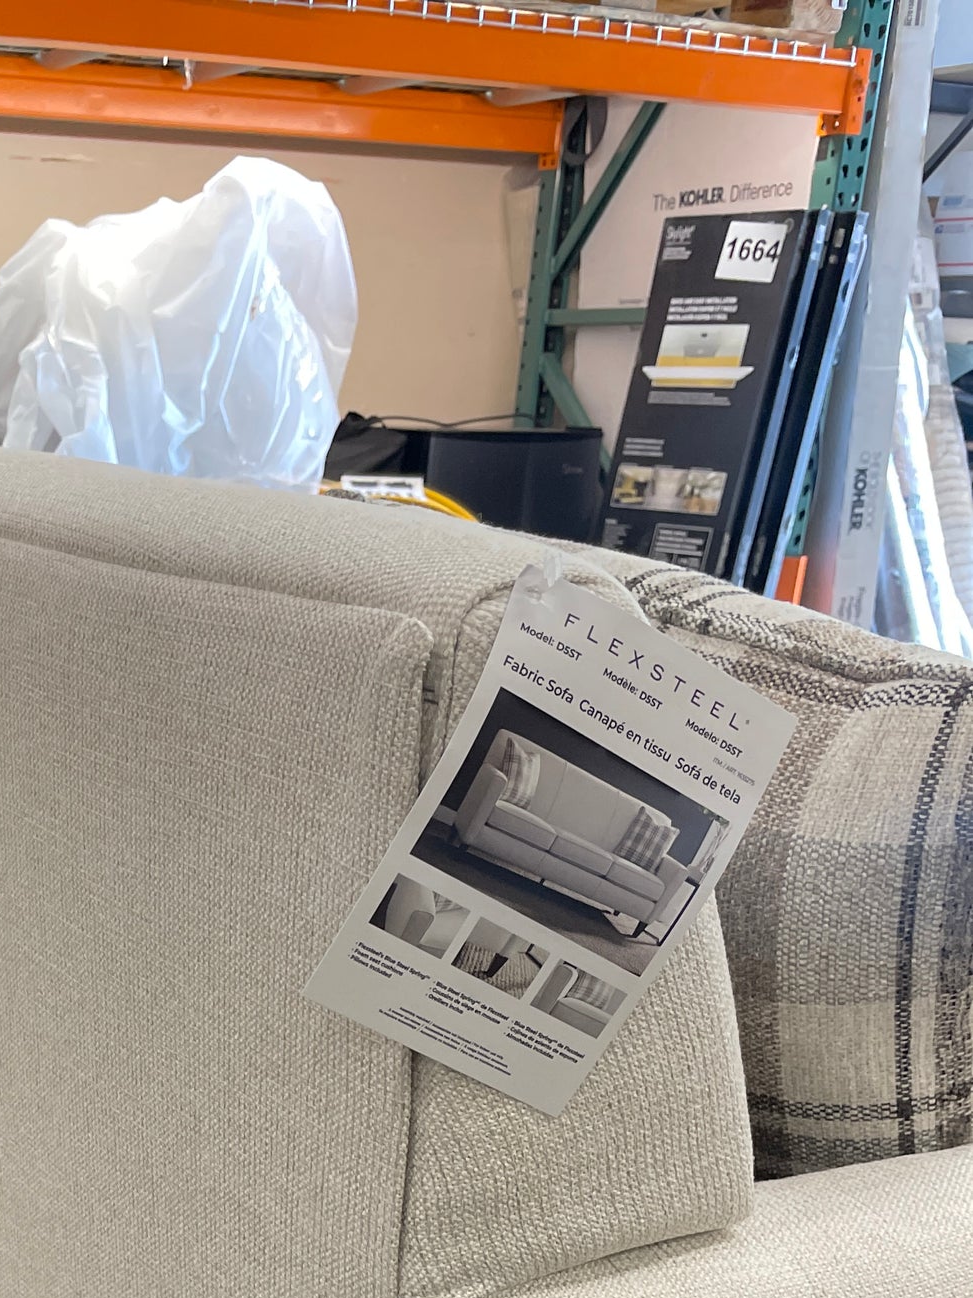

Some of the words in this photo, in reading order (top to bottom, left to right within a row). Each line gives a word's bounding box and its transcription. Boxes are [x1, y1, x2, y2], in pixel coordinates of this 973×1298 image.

[652, 193, 675, 211] The
[678, 186, 724, 208] KOHLER
[730, 181, 793, 203] Difference
[727, 237, 781, 263] 1664
[849, 468, 868, 531] KOHLER
[519, 622, 555, 646] Model:
[555, 641, 582, 661] D5ST
[502, 654, 545, 686] Fabric
[545, 679, 573, 704] Sofa
[563, 612, 739, 731] FLEXSTEEL
[602, 667, 638, 695] Modèle:
[638, 690, 663, 710] D5ST
[579, 699, 625, 734] Canapé
[625, 729, 641, 745] en
[643, 737, 671, 762] tissu
[684, 718, 719, 745] Modelo:
[719, 739, 743, 758] D5ST
[674, 757, 702, 780] Sofá
[702, 774, 717, 790] de
[718, 783, 740, 804] tela
[383, 955, 396, 964] Blue
